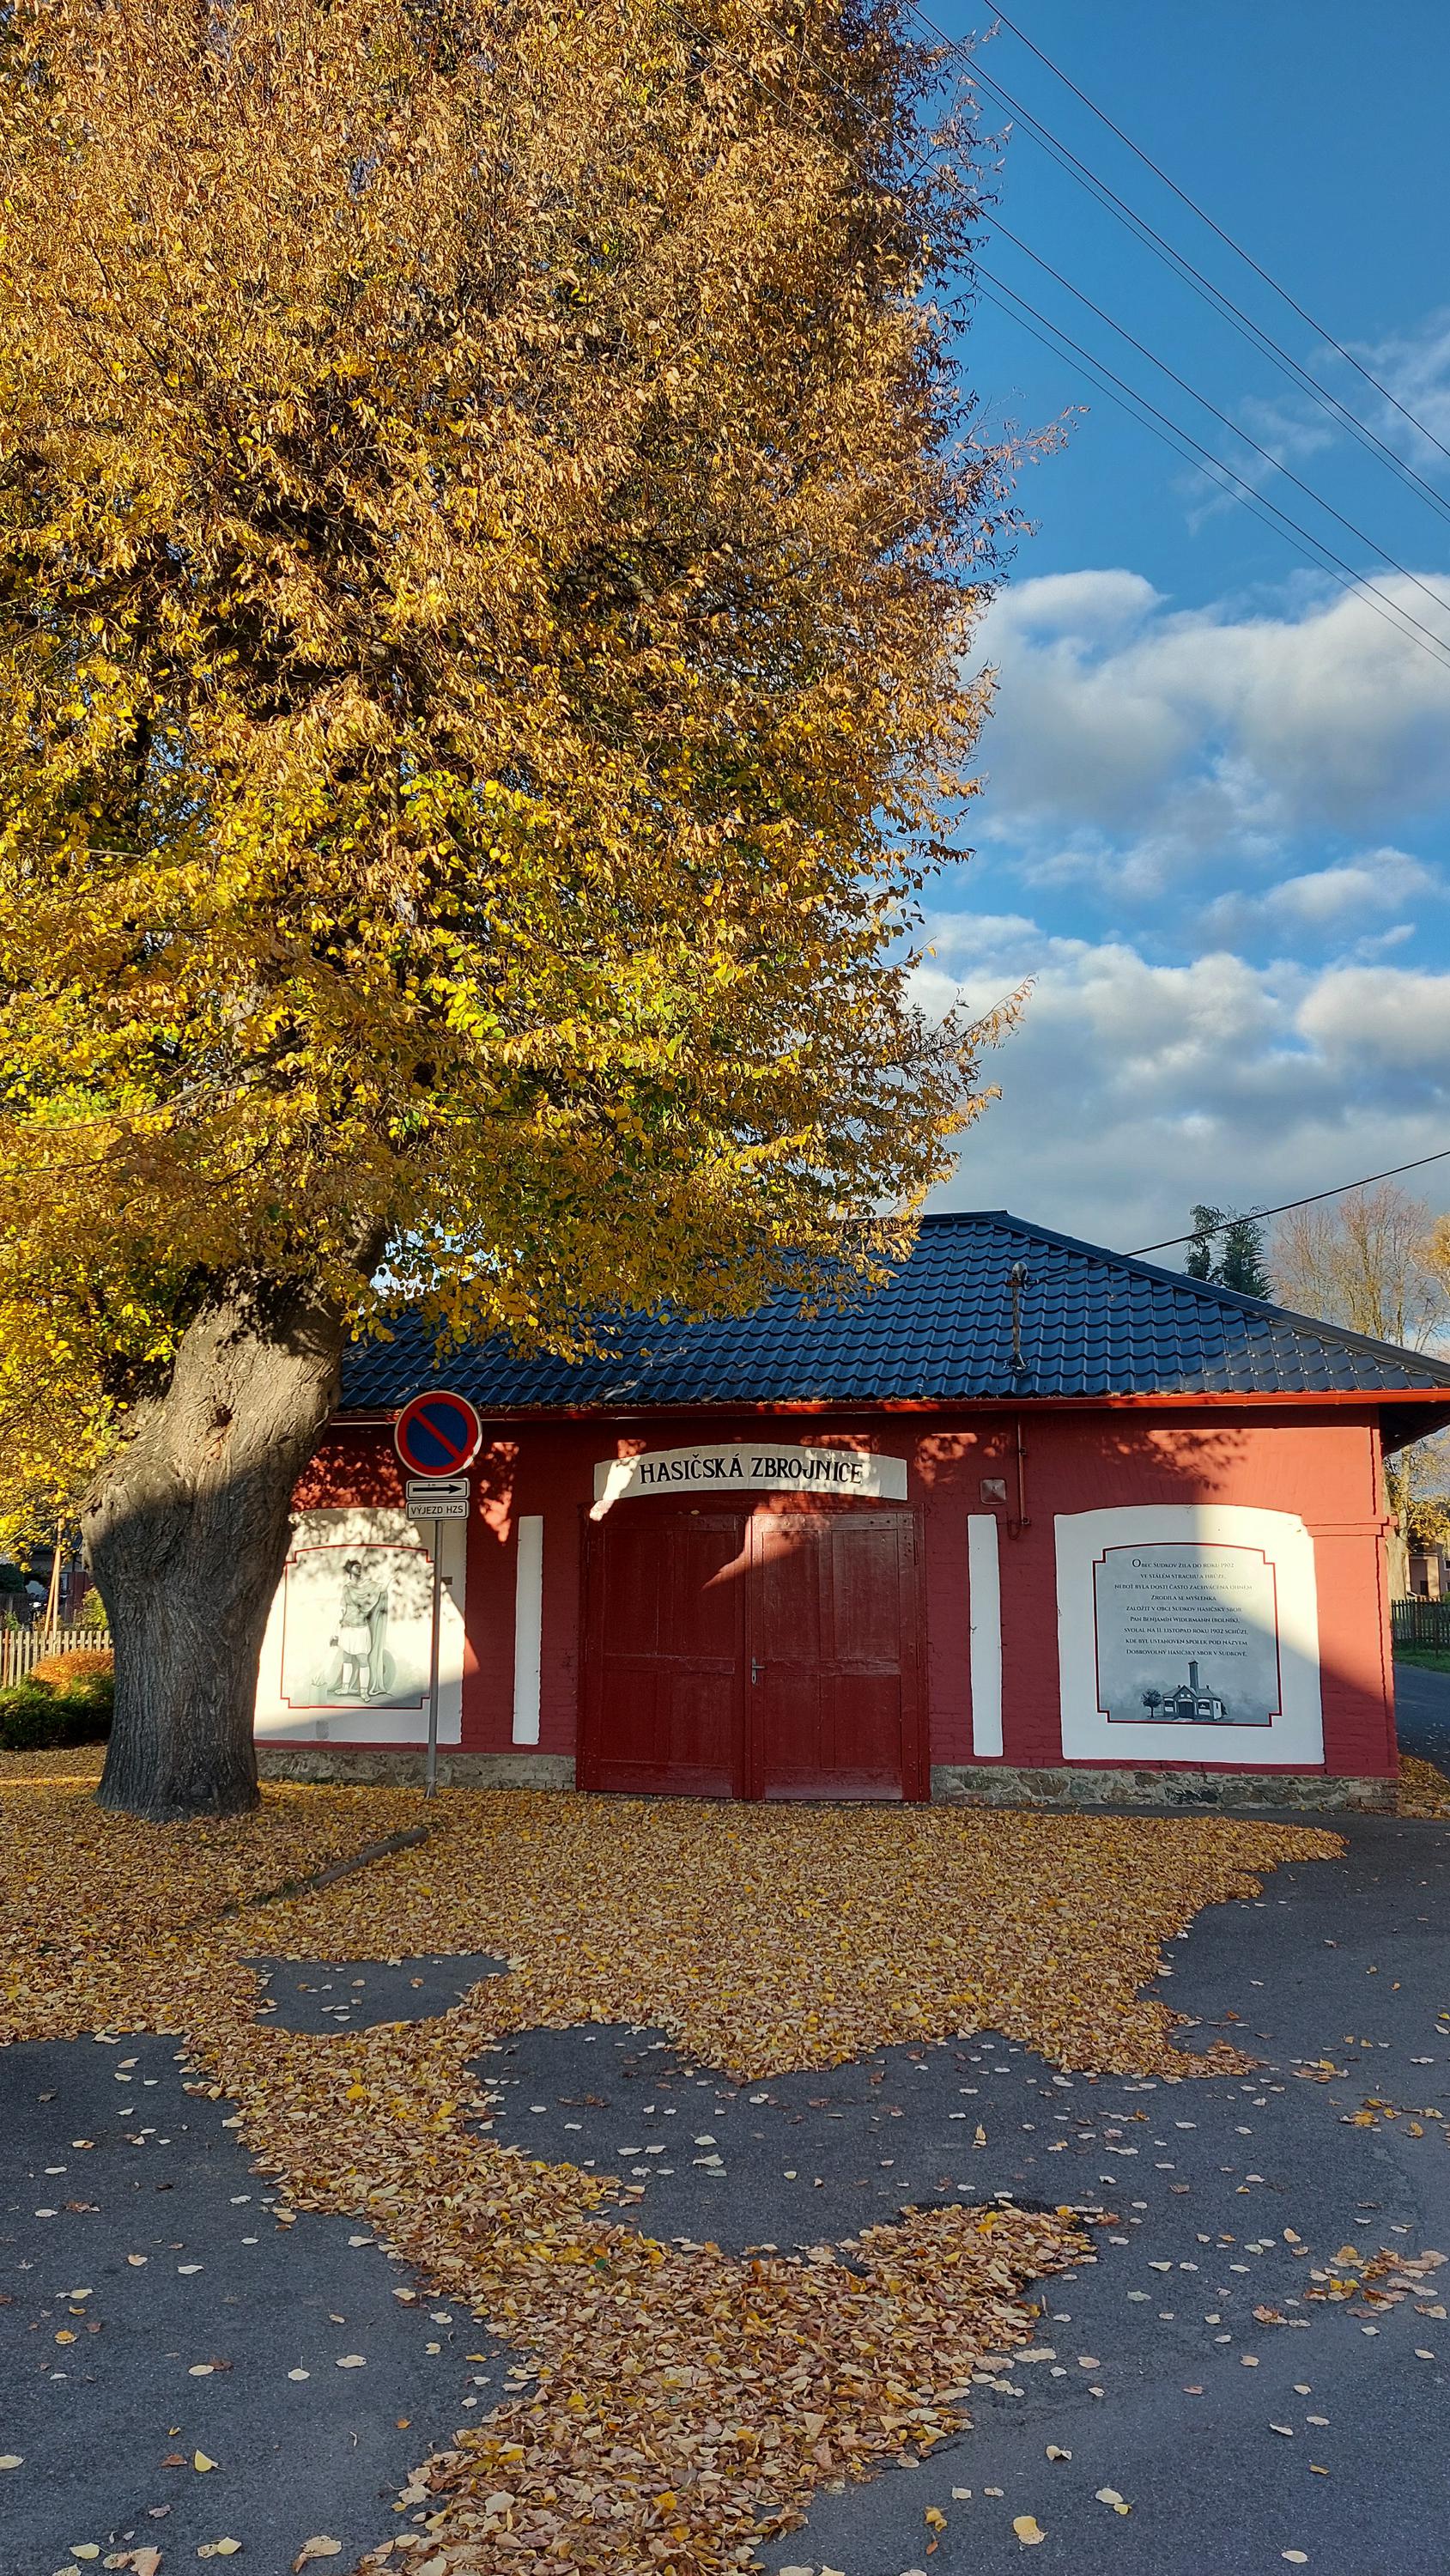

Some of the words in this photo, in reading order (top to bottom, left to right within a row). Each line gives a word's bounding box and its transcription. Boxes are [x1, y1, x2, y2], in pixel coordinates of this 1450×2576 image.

[640, 1453, 744, 1484] HASIČSKÁ
[750, 1457, 863, 1484] ZBROJNICE
[411, 1504, 443, 1515] VÝJEZD
[446, 1505, 464, 1514] HZS
